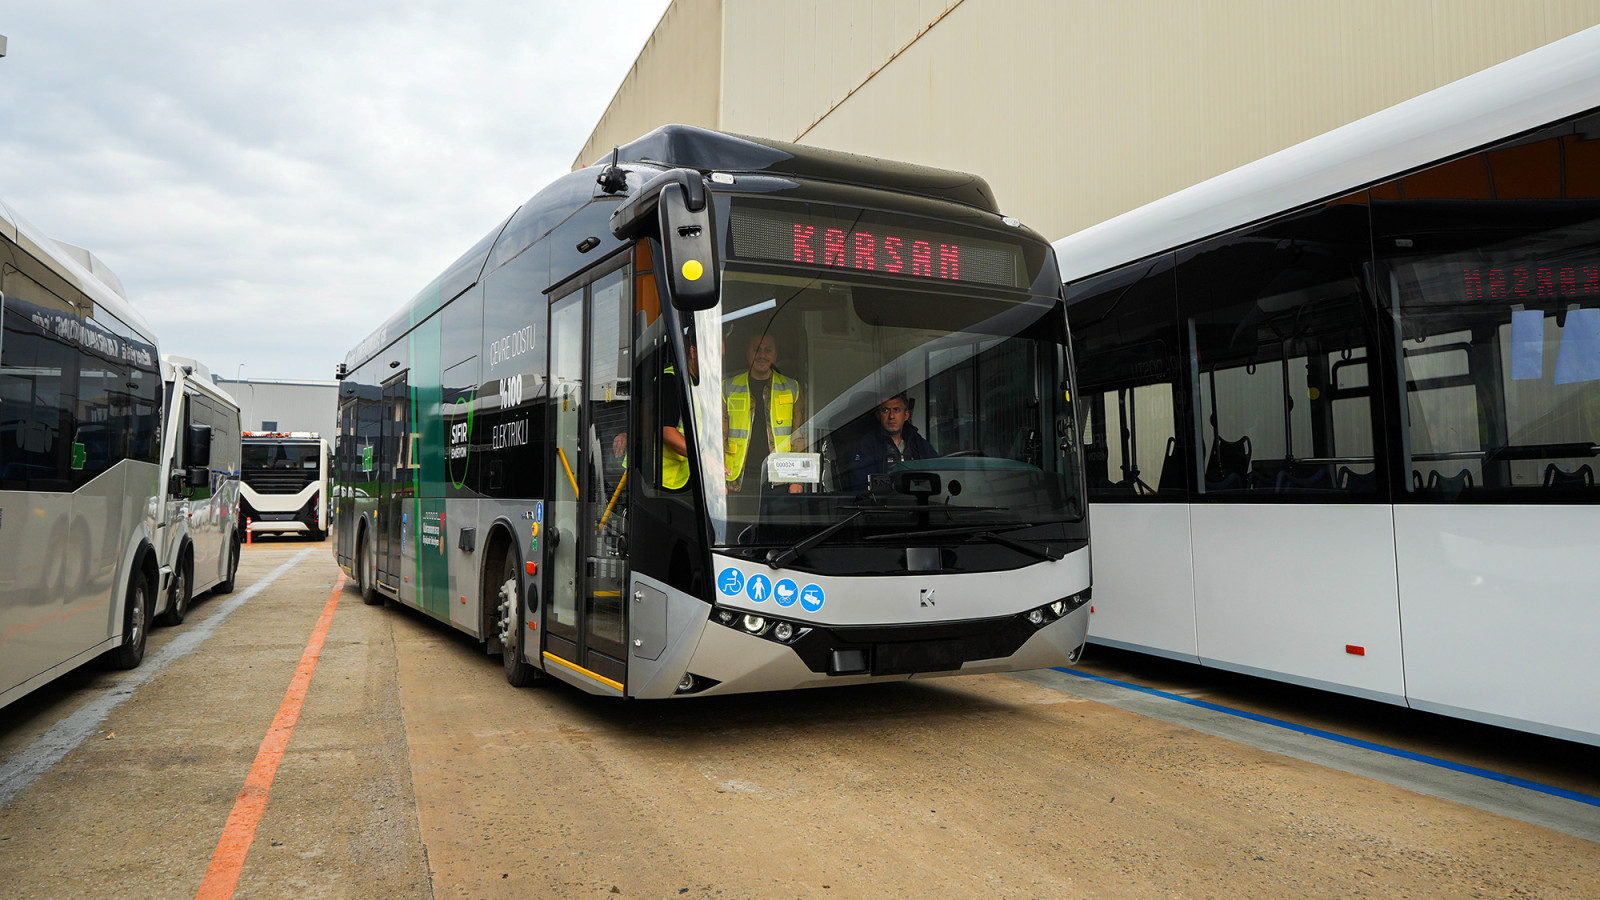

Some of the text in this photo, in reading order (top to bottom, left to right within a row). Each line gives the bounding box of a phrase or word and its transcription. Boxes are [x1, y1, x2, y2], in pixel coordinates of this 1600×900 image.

[490, 323, 536, 372] ÇEVRE DOSTU
[499, 373, 523, 410] %100
[451, 422, 468, 445] SIFIR
[492, 411, 529, 450] ELEKTRİKLİ
